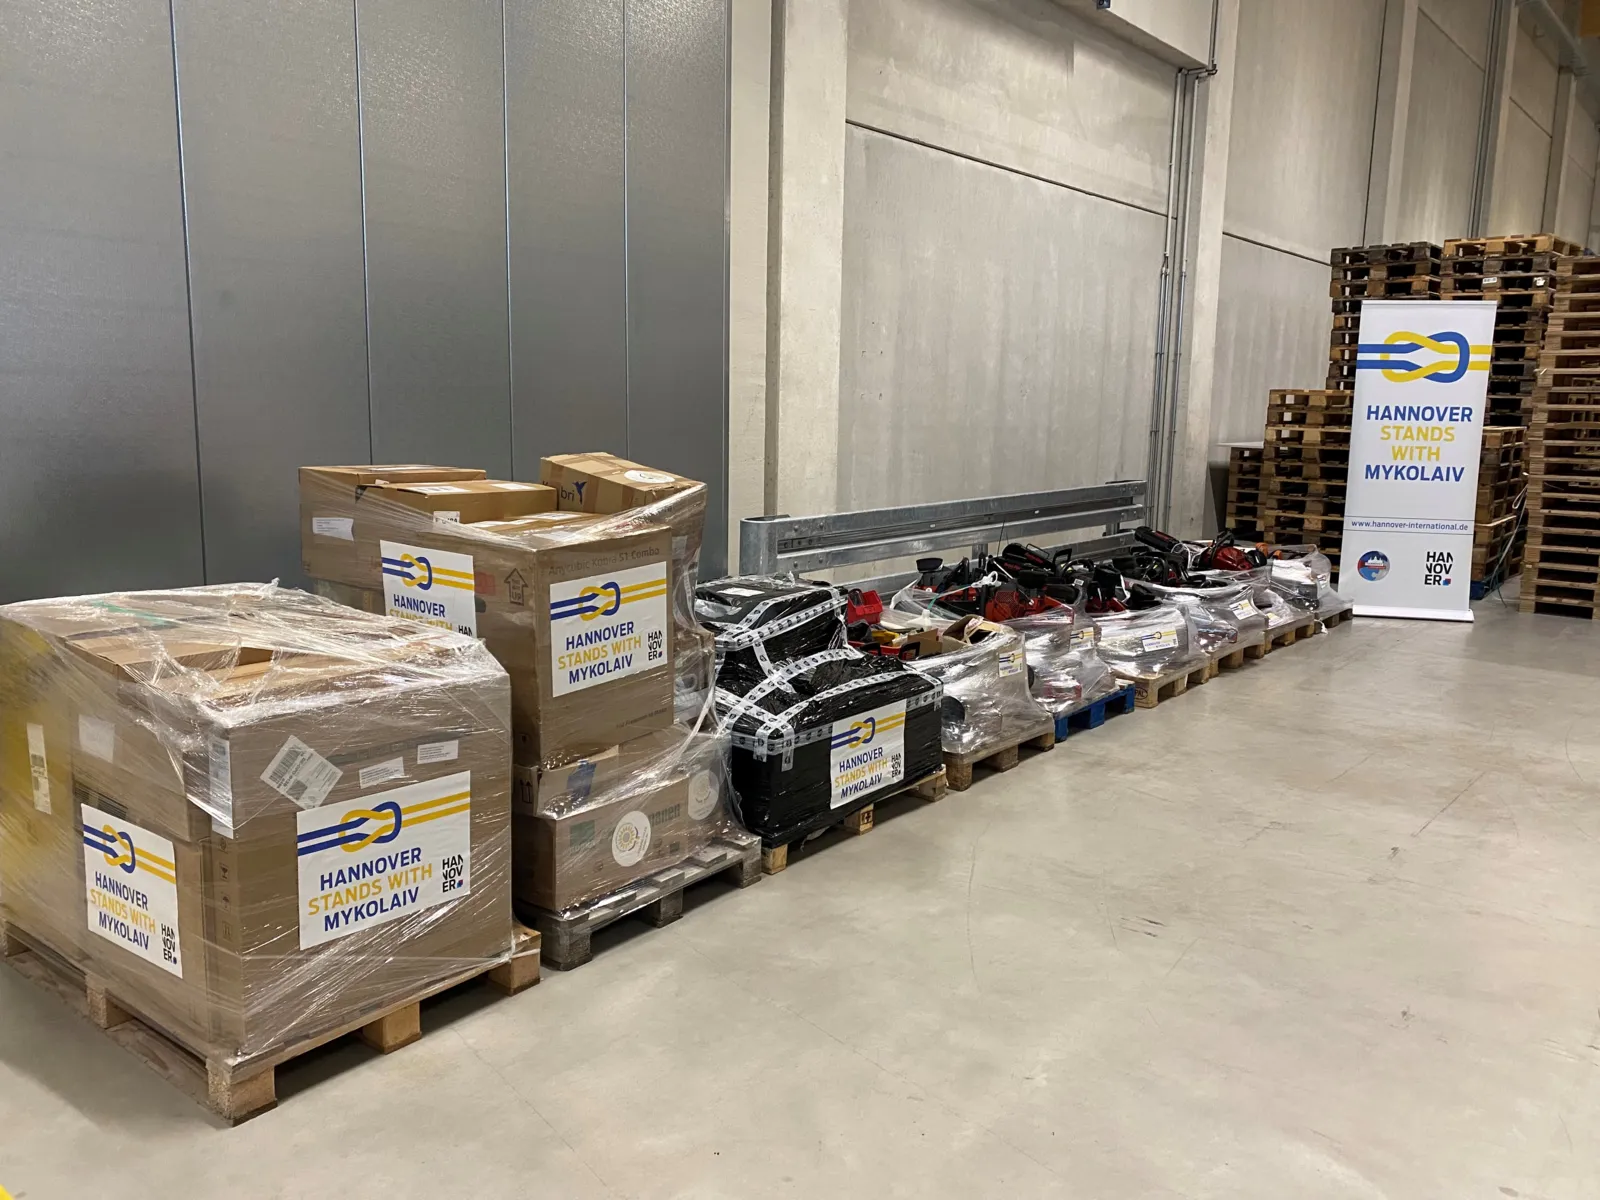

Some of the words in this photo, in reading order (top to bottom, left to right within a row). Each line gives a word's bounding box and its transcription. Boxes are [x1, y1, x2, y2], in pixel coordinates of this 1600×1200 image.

[1366, 405, 1473, 422] HANNOVER
[1380, 425, 1456, 442] STANDS
[1391, 445, 1441, 462] WITH
[1364, 464, 1465, 482] MYKOLAIV
[1351, 520, 1468, 531] www.hannover-international.de
[631, 547, 660, 560] Combo
[393, 593, 446, 618] HANNOVER
[566, 621, 634, 651] HANNOVER
[558, 645, 608, 670] STANDS
[612, 635, 642, 653] WITH
[569, 653, 633, 685] MYKOLAIV
[835, 767, 866, 788] STANDS
[868, 758, 888, 774] WITH
[839, 747, 883, 773] HANNOVER
[840, 773, 882, 799] MYKOLAIV
[320, 847, 422, 891] HANNOVER
[95, 871, 148, 911] HANNOVER
[308, 879, 383, 916] STANDS
[388, 863, 433, 891] WITH
[90, 889, 128, 920] STANDS
[129, 907, 156, 934] WITH
[324, 886, 420, 932] MYKOLAIV
[99, 911, 149, 950] MYKOLAIV
